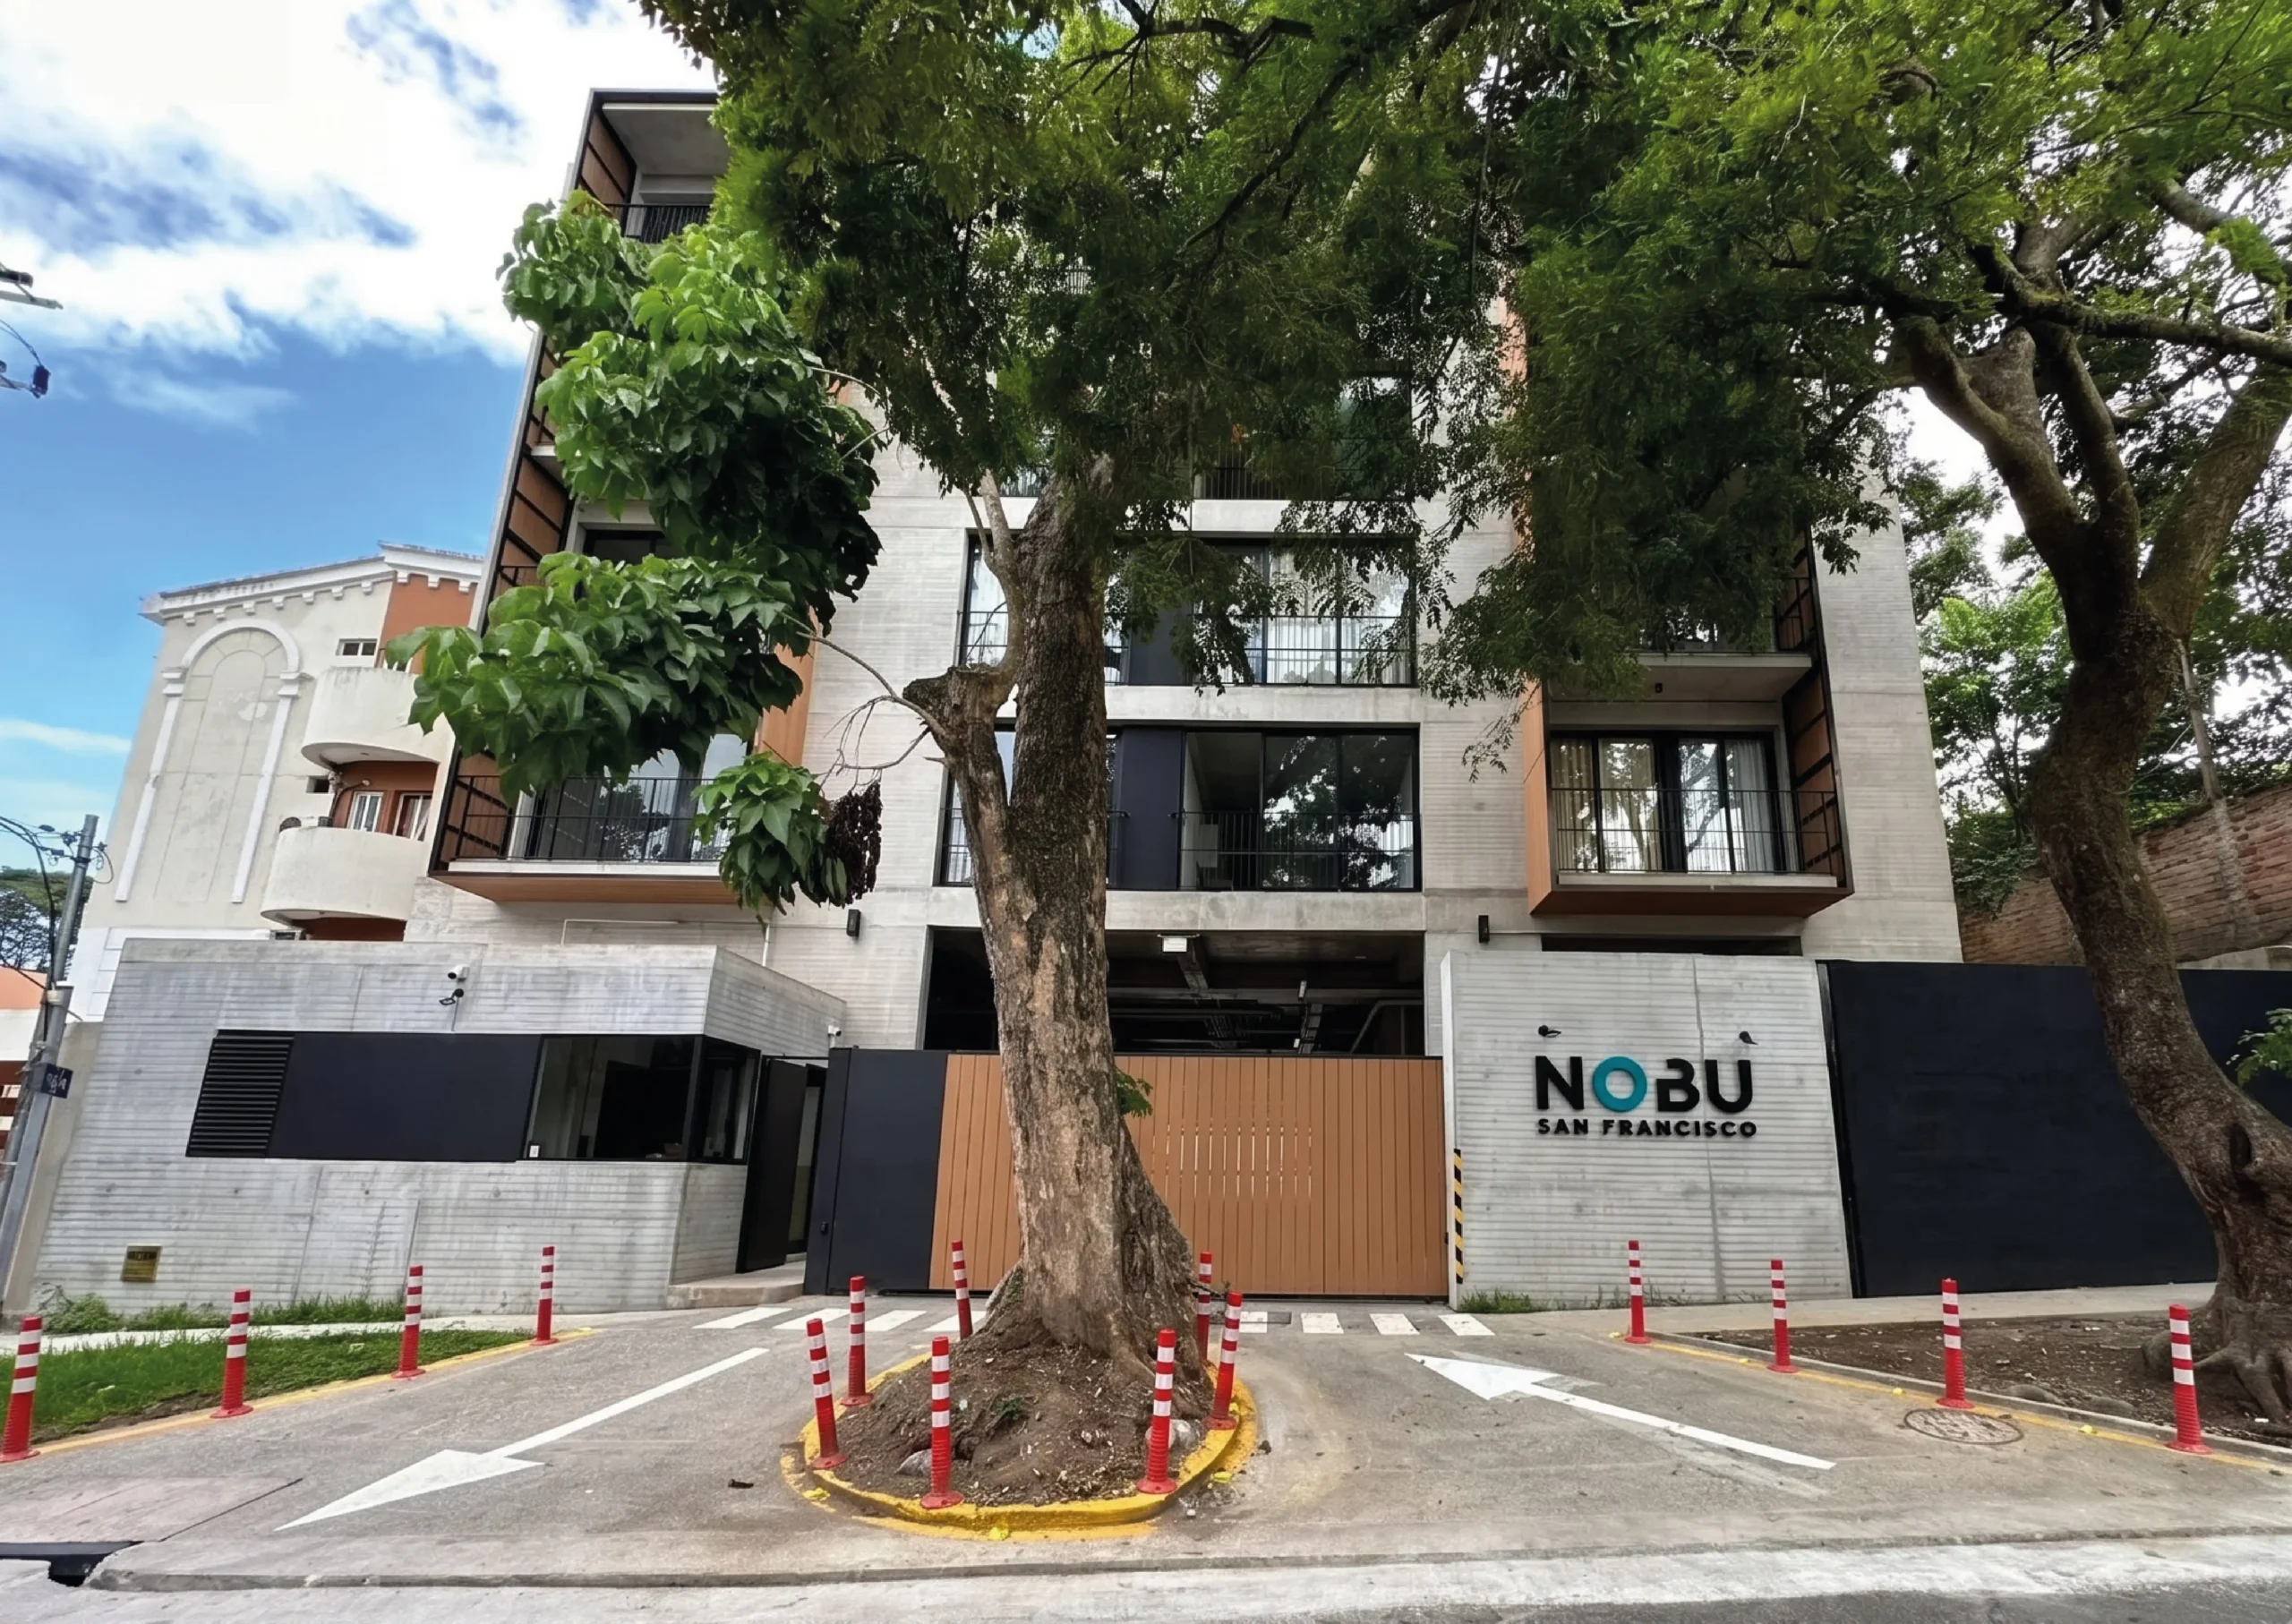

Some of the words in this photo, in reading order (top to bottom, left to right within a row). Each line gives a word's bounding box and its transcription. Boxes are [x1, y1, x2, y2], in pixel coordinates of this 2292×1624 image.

[1535, 1056, 1753, 1114] NOBU
[1537, 1118, 1589, 1135] SAN
[1603, 1119, 1757, 1138] FRANCISCO
